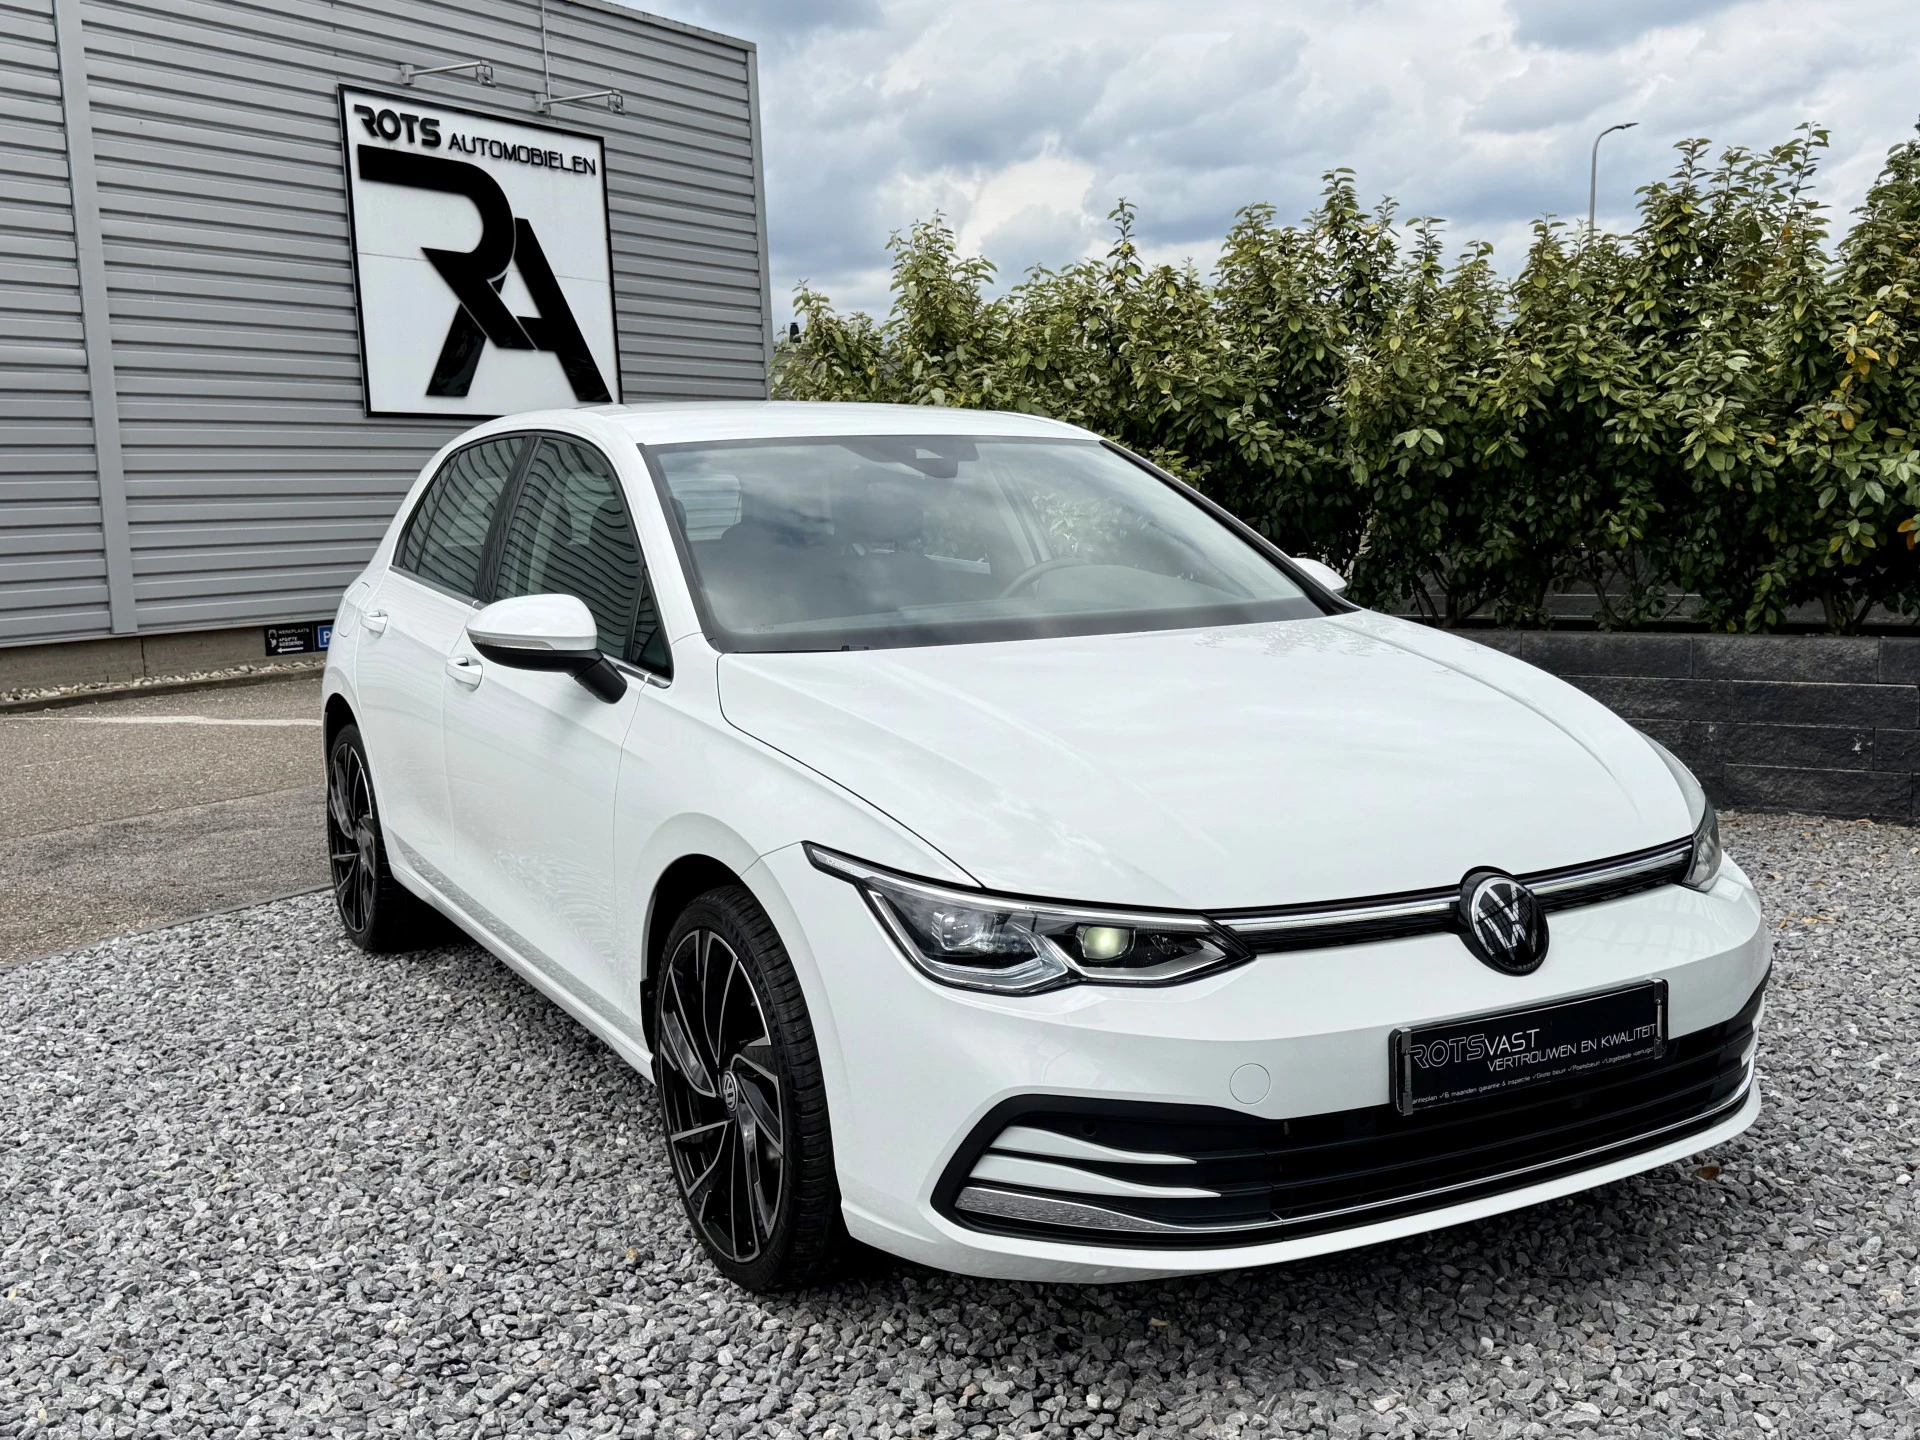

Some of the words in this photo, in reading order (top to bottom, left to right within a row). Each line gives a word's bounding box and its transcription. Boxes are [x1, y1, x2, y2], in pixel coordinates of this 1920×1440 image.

[354, 104, 442, 148] ROTS
[448, 132, 597, 176] AUTOMOBIELEN
[1486, 1042, 1577, 1072] VERTROUWEN
[1580, 1038, 1598, 1053] EN
[1601, 1023, 1657, 1049] KWALITEIT
[1411, 1095, 1438, 1105] antieplan
[1451, 1087, 1477, 1096] maanden
[1478, 1082, 1501, 1093] garantie
[1507, 1076, 1531, 1086] inspectie
